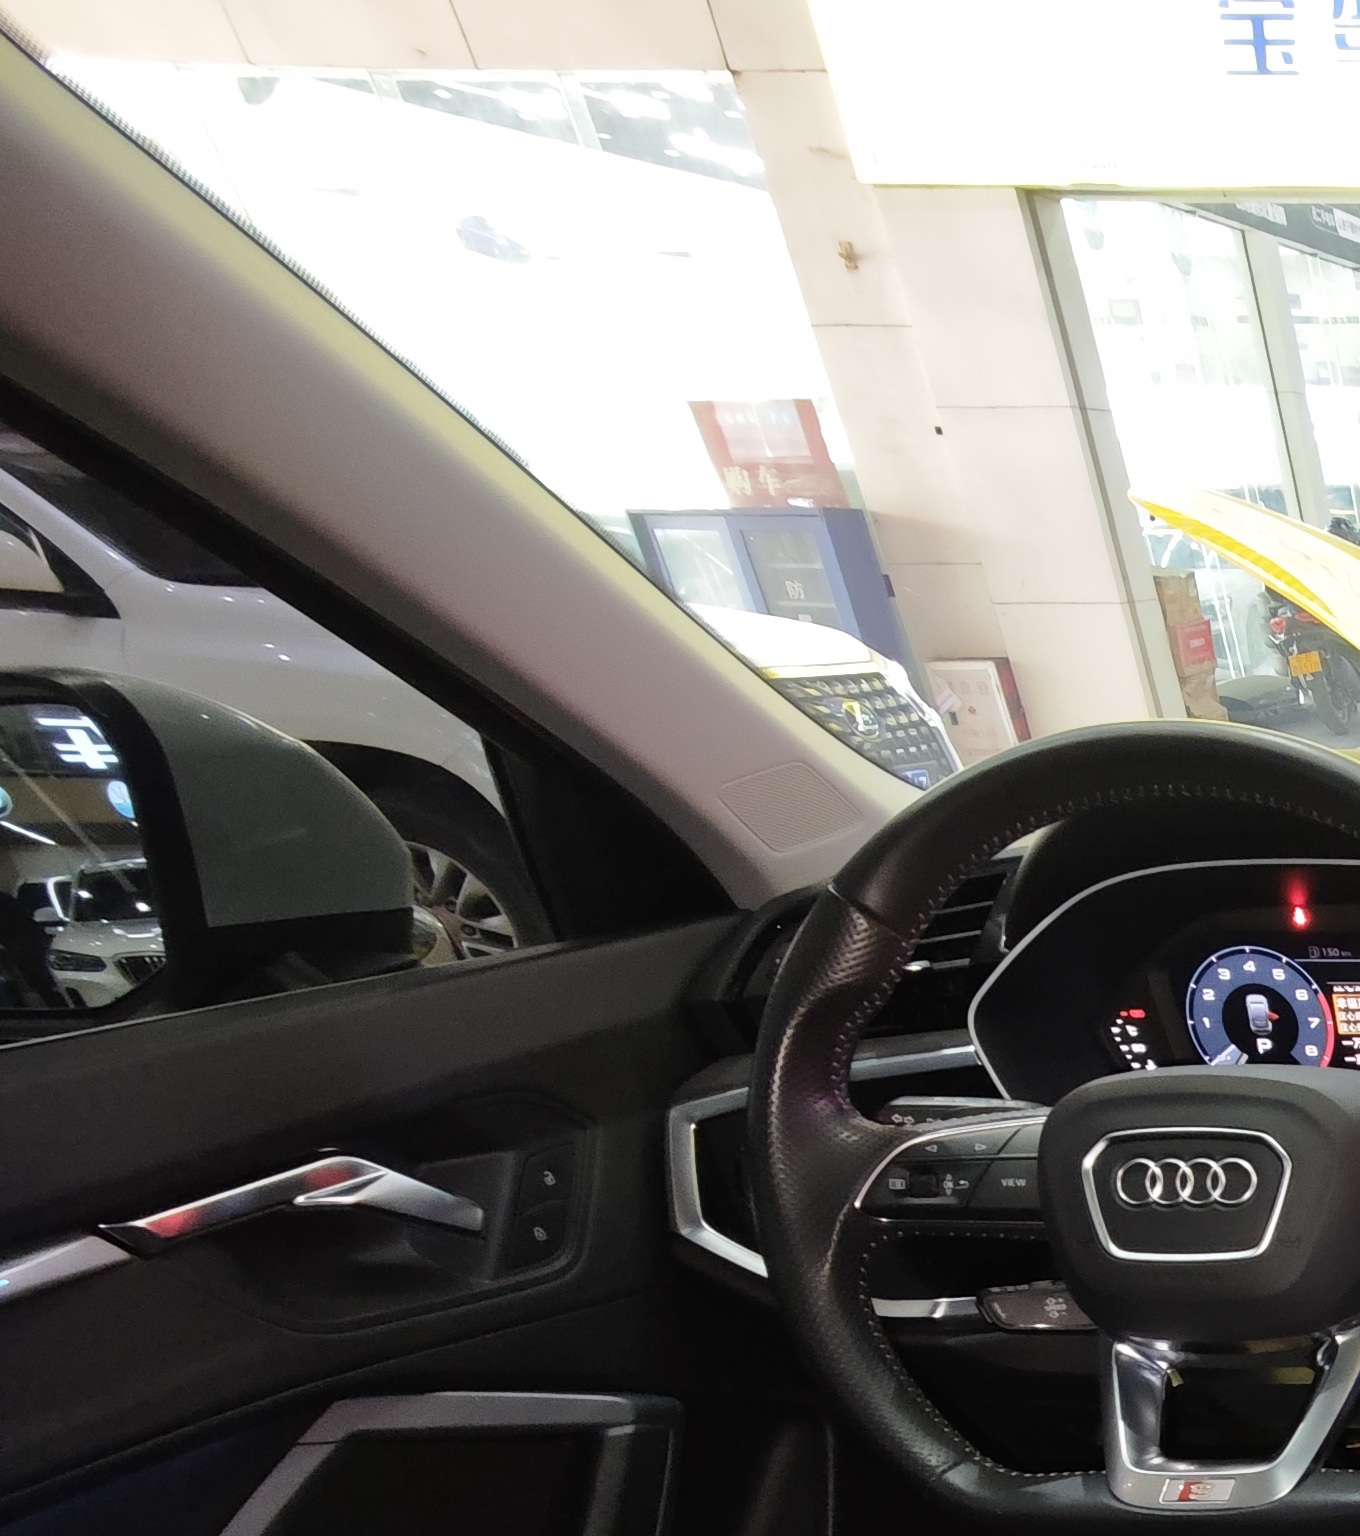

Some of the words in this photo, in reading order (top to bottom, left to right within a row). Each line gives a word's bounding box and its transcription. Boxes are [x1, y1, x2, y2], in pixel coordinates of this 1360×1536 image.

[1321, 947, 1339, 957] 150
[1243, 960, 1256, 972] 4
[1217, 968, 1231, 981] 3
[1272, 968, 1286, 981] 5
[1202, 988, 1215, 1001] 2
[1294, 989, 1309, 1001] 6
[1202, 1016, 1211, 1029] 1
[1307, 1017, 1321, 1029] 7
[1256, 1037, 1273, 1055] P
[1304, 1044, 1319, 1057] 8
[1001, 1178, 1027, 1187] VIEW
